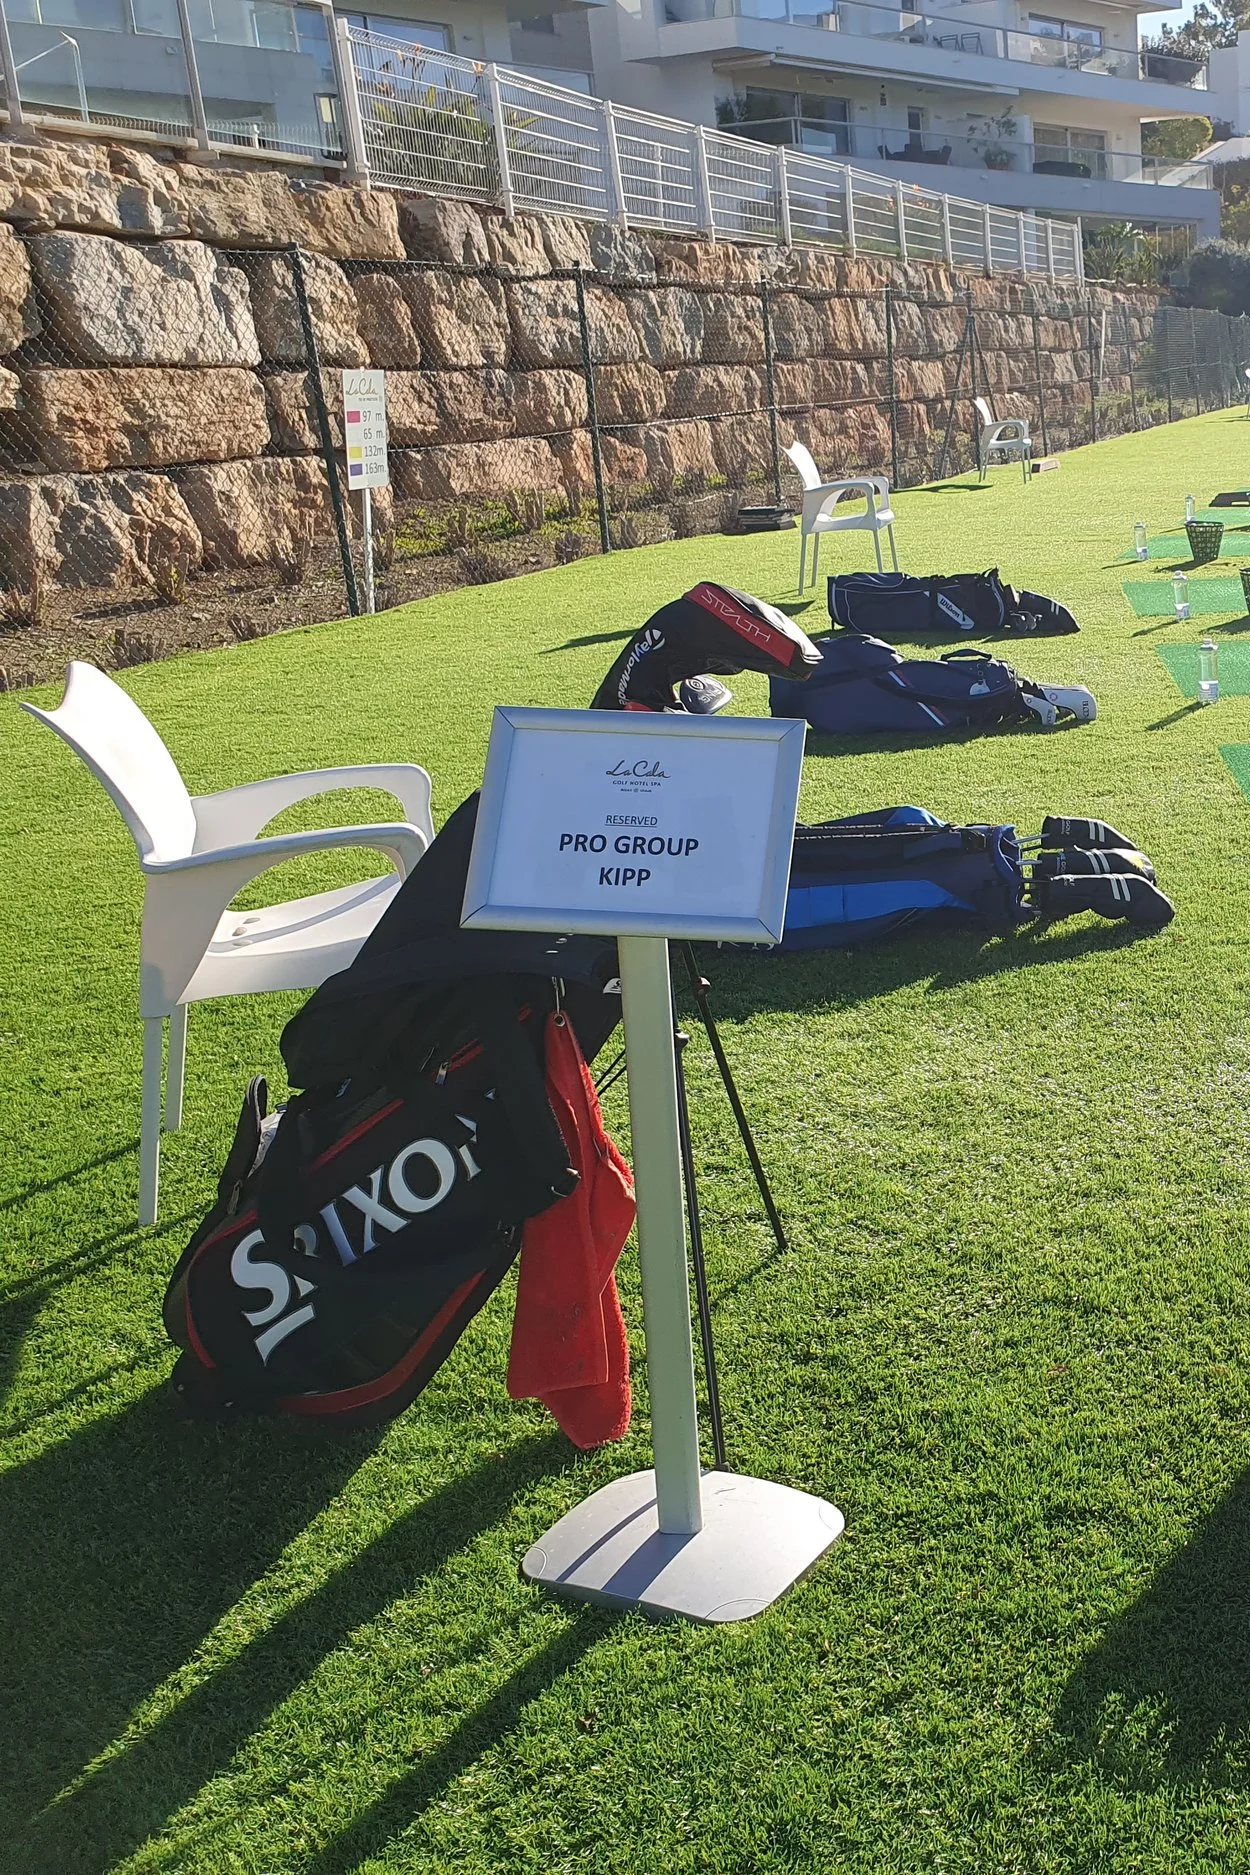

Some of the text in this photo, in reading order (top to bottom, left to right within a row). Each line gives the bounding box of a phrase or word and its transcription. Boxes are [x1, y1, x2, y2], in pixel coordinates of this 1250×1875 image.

[362, 410, 384, 422] 97 m.
[363, 428, 385, 440] 65 m.
[364, 445, 386, 457] 132m.
[365, 462, 387, 475] 163m.
[940, 598, 960, 618] Wilson
[618, 628, 666, 706] TaylorMade
[605, 759, 672, 779] La Cala
[605, 814, 658, 826] RESERVED
[559, 833, 699, 857] PRO GROUP
[598, 866, 651, 887] KIPP
